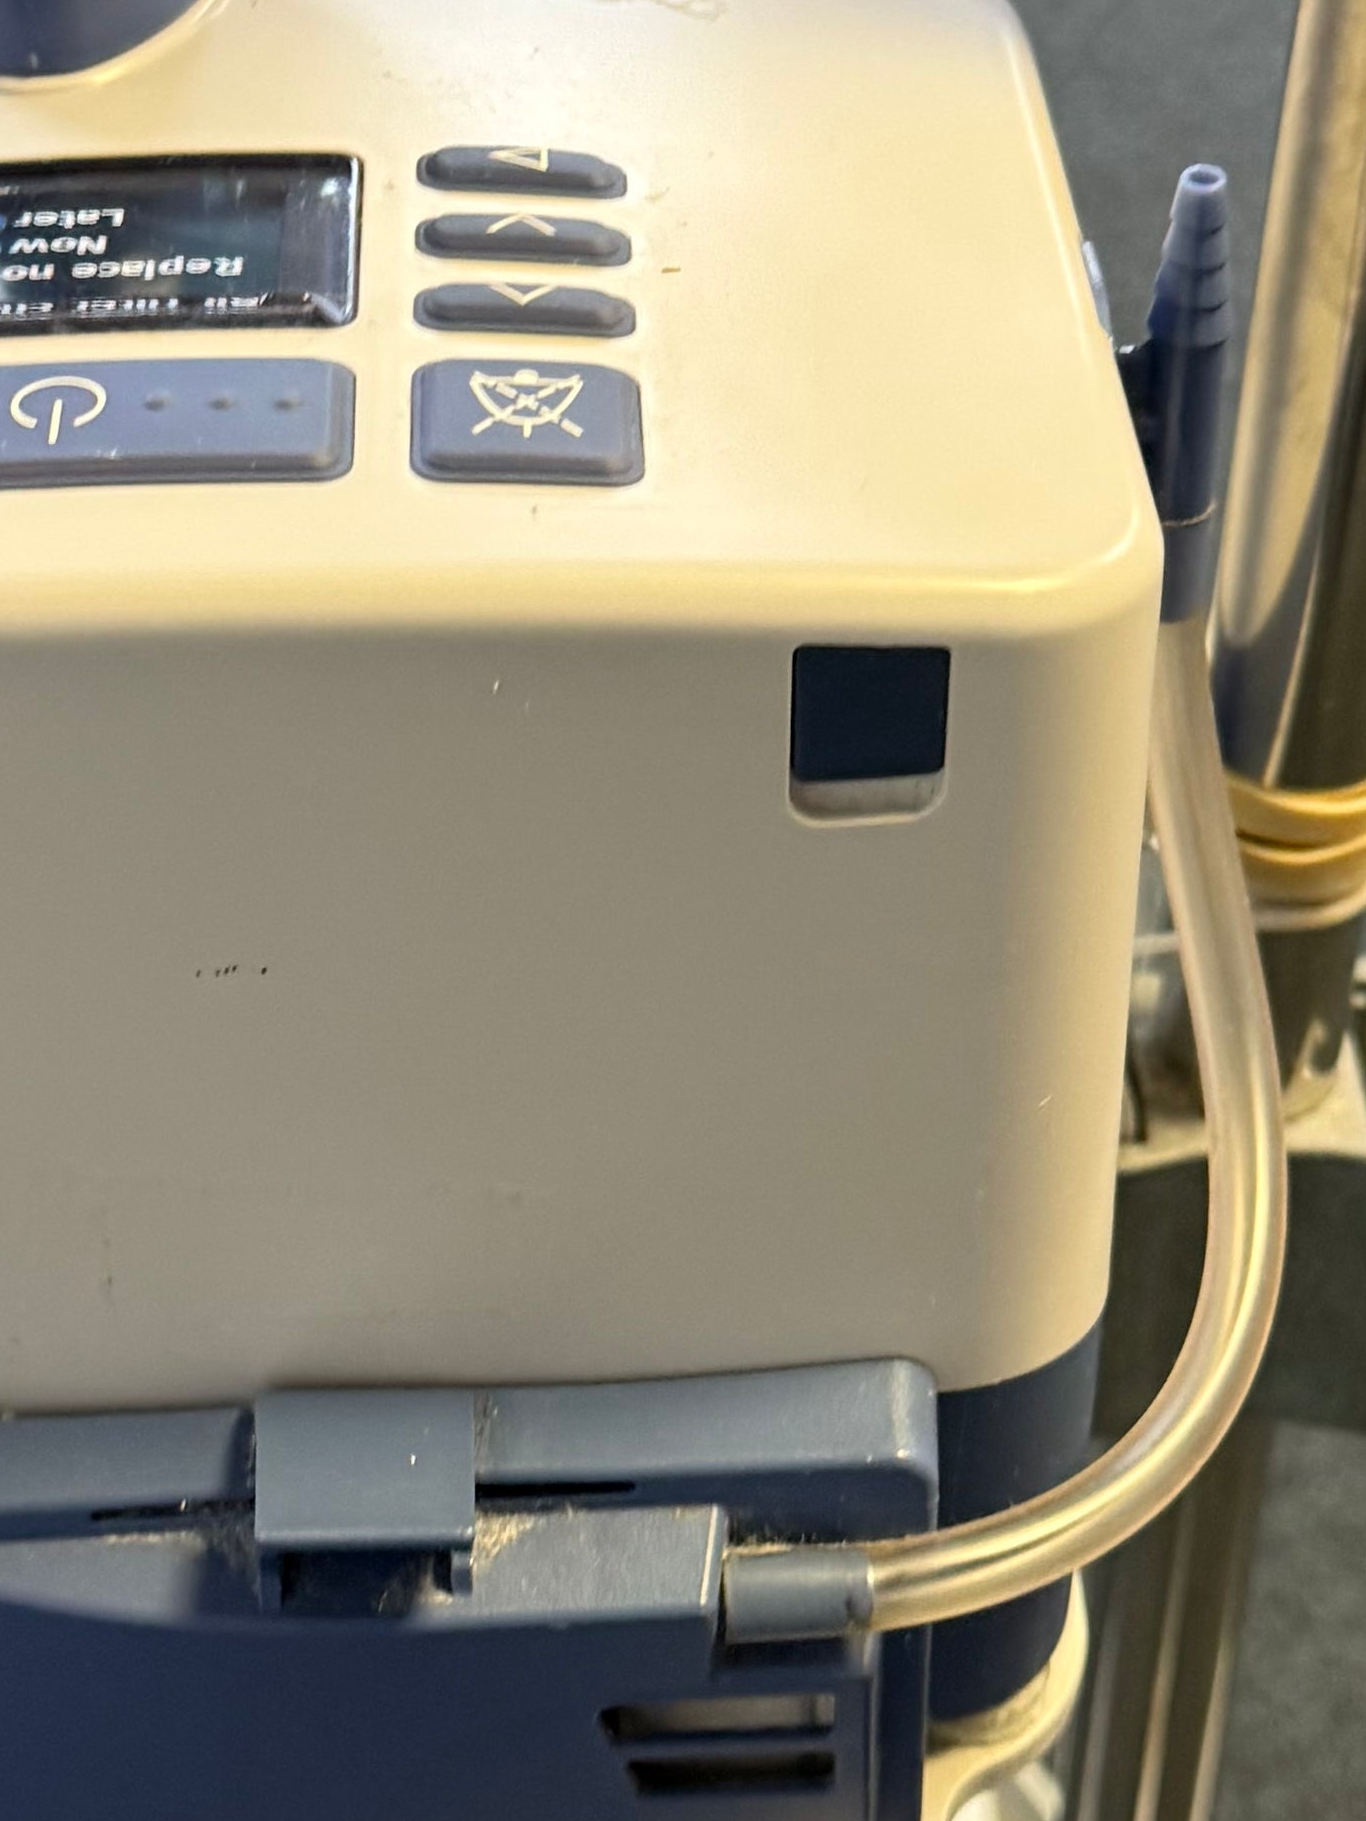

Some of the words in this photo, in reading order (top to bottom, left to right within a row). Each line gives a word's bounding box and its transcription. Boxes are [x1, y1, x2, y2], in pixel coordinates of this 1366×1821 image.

[14, 208, 126, 229] Later
[8, 235, 108, 256] Now
[71, 255, 245, 280] Replace
